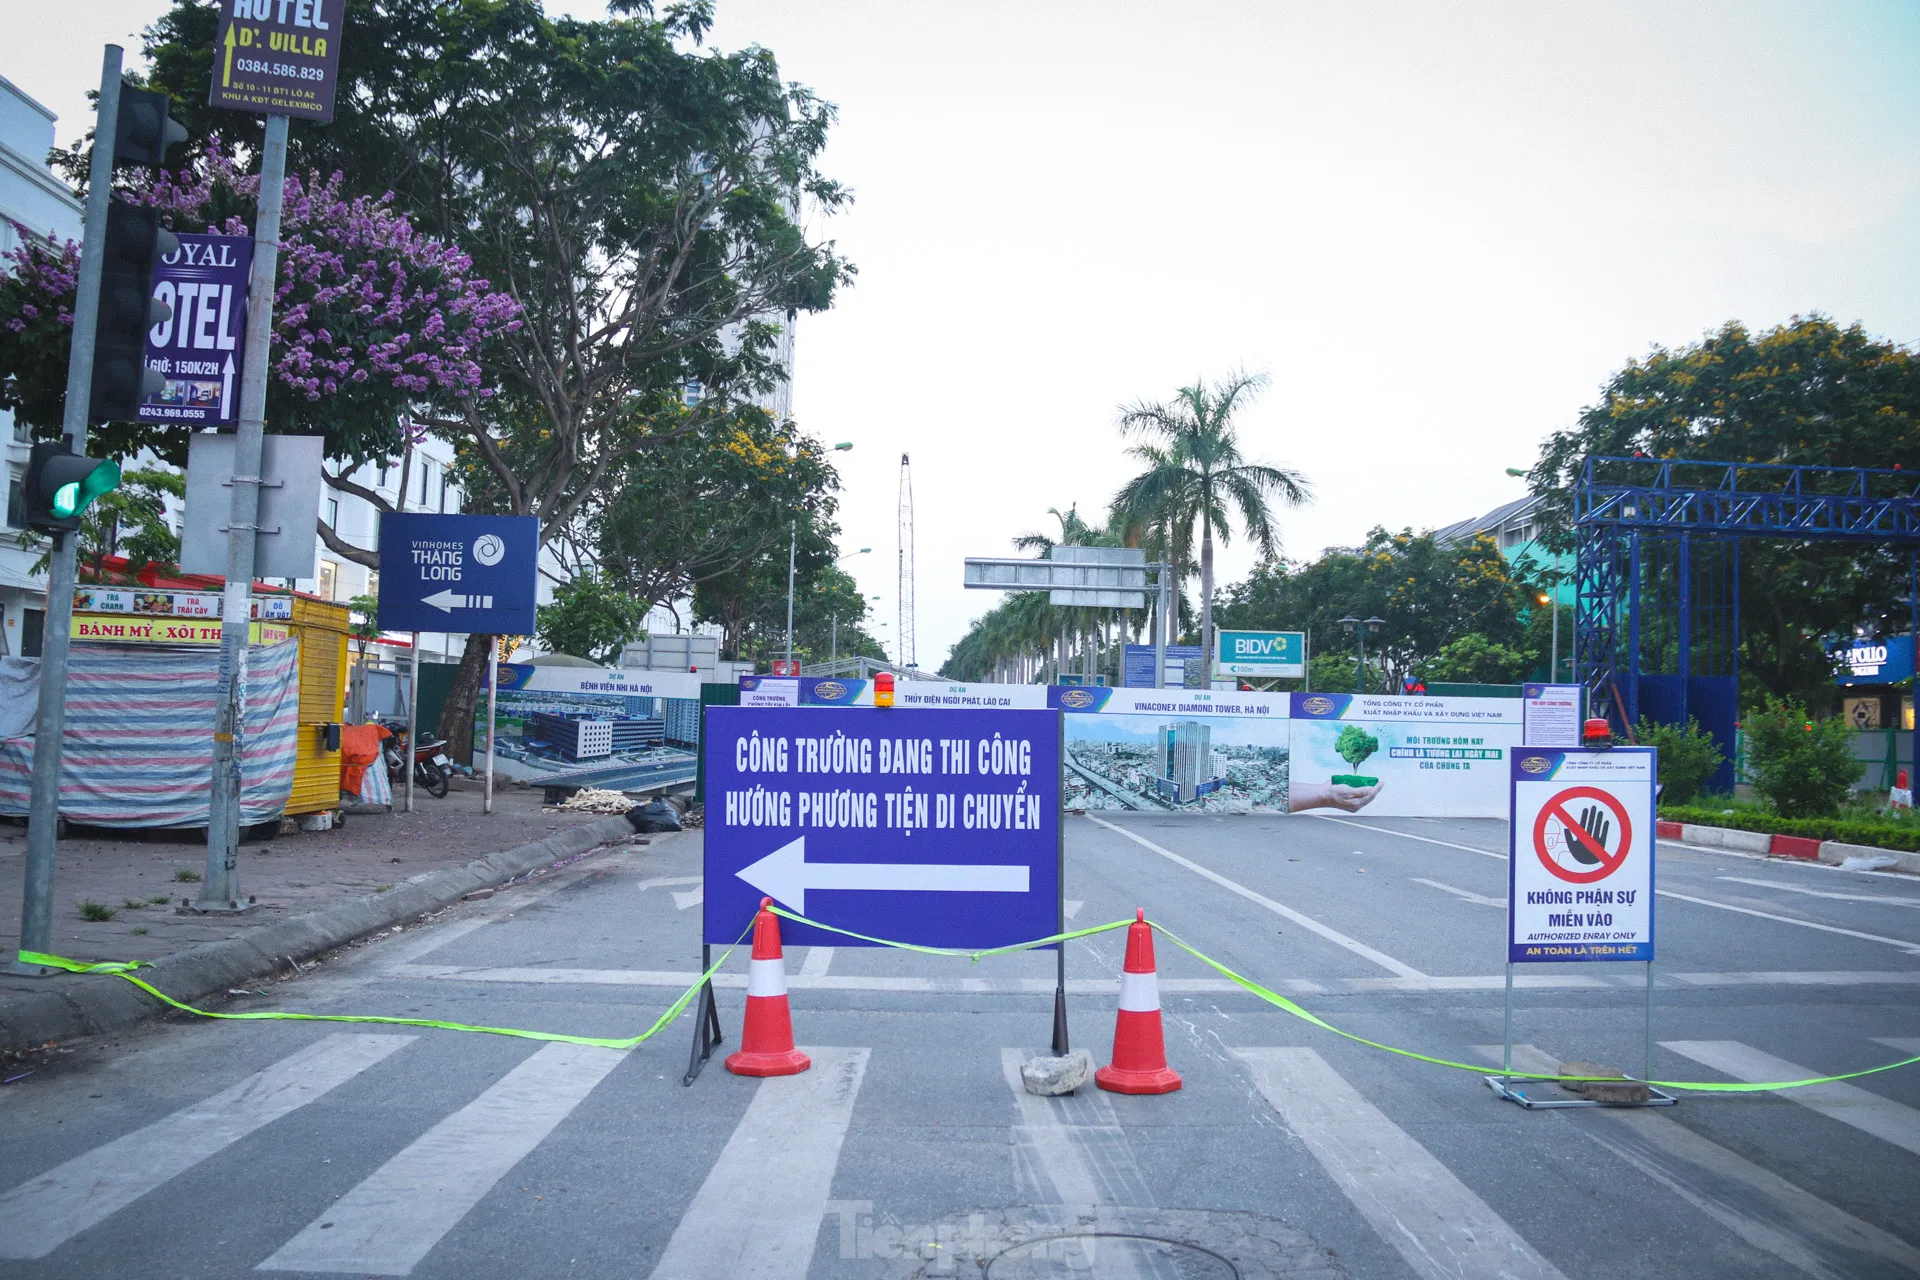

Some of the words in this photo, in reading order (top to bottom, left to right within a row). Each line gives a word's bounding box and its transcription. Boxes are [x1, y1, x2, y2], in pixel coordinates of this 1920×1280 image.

[237, 58, 324, 81] 0384.586.829
[246, 84, 255, 92] 10
[304, 91, 315, 99] A2
[222, 92, 241, 100] KHU
[271, 98, 323, 111] GELEXIMCO
[161, 243, 237, 267] OYAL
[149, 280, 235, 350] OTEL
[175, 361, 219, 375] 150K/2H
[139, 407, 205, 419] 0243.969.0555
[412, 540, 464, 550] VINHOMES
[421, 566, 462, 581] LONG
[100, 602, 124, 610] CHANH
[79, 621, 125, 637] BÁNH
[166, 624, 196, 639] XÔI
[200, 628, 222, 640] TH
[1235, 638, 1273, 655] BIDV
[1135, 702, 1177, 712] VINACONEX
[1178, 704, 1213, 713] DIAMOND
[1256, 705, 1270, 716] NỘI
[736, 730, 788, 773] CÔNG
[796, 730, 872, 774] TRƯỜNG
[879, 738, 932, 775] ĐANG
[940, 739, 970, 775] THI
[978, 732, 1031, 775] CÔNG
[726, 784, 791, 827] HƯỚNG
[798, 789, 877, 829] PHƯƠNG
[885, 786, 929, 836] TIỆN
[936, 794, 955, 829] DI
[963, 780, 1040, 830] CHUYỂN
[1527, 889, 1573, 905] KHÔNG
[1576, 888, 1613, 907] PHẬN
[1617, 889, 1637, 907] SỰ
[1549, 909, 1583, 927] MIỄN
[1587, 911, 1613, 927] VÀO
[1527, 933, 1581, 941] AUTHORIZED
[1583, 932, 1611, 940] ENRAY
[1612, 932, 1637, 940] ONLY
[1526, 947, 1541, 955] AN
[1543, 946, 1572, 955] TOÀN
[1574, 944, 1587, 955] LÀ
[1589, 944, 1616, 954] TRÊN
[1618, 943, 1638, 954] HẾT
